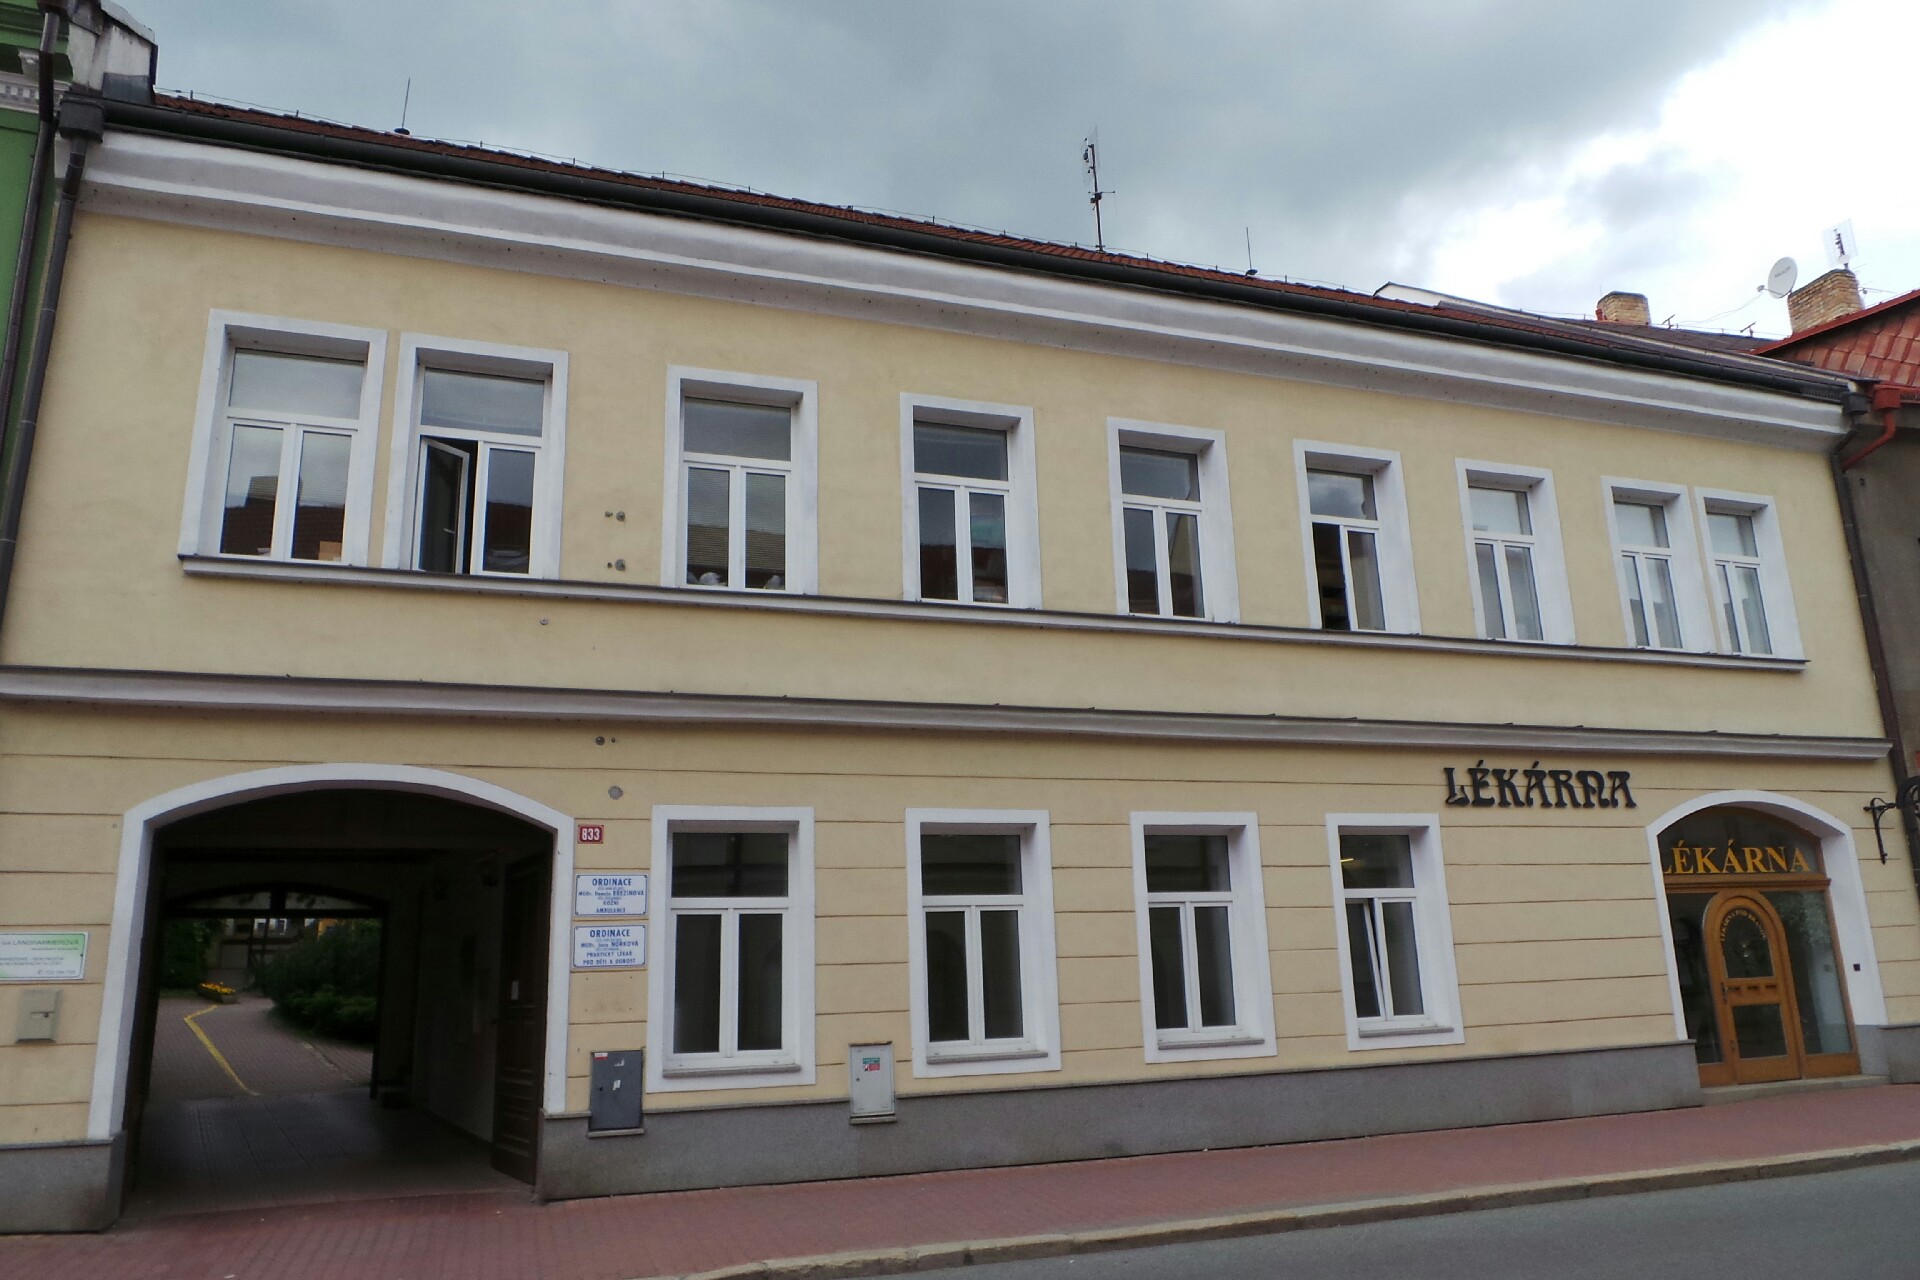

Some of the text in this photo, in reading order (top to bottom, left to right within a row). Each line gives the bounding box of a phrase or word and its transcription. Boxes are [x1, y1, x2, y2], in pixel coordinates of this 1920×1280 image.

[1443, 759, 1637, 809] LÉKÁRNA
[581, 828, 600, 841] 833
[591, 878, 632, 886] ORDINACE
[589, 929, 630, 938] ORDINACE
